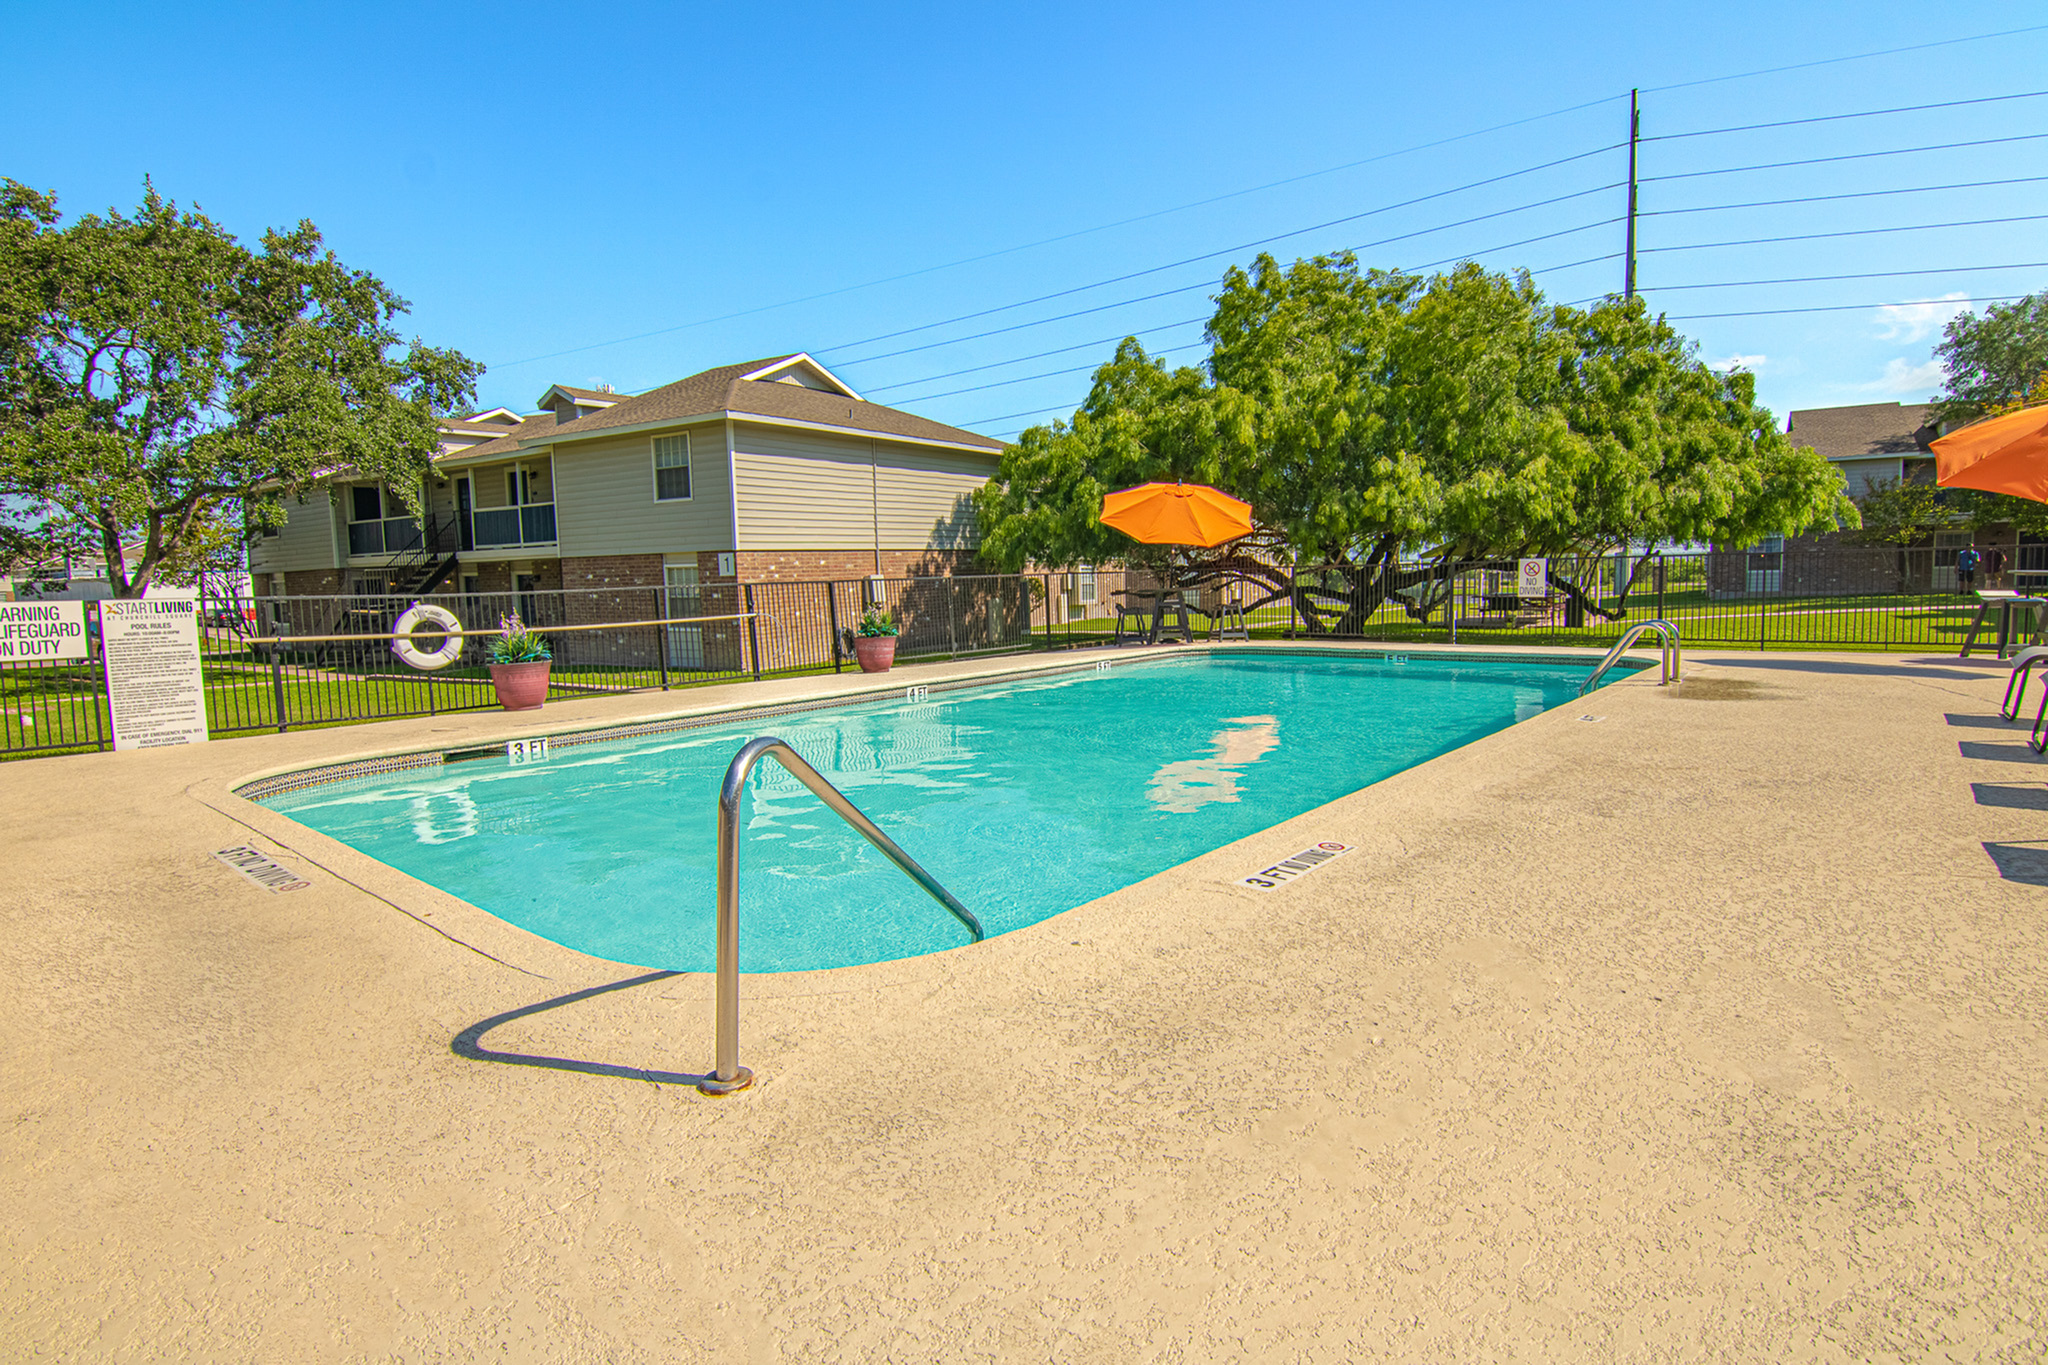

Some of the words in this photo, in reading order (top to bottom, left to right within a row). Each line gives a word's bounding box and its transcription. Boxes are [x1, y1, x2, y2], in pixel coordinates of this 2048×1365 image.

[724, 556, 730, 573] 1
[1525, 577, 1537, 586] NO
[1519, 586, 1544, 596] DIVING
[19, 639, 61, 656] DUTY
[1259, 866, 1297, 881] FT
[1245, 877, 1276, 888] 3
